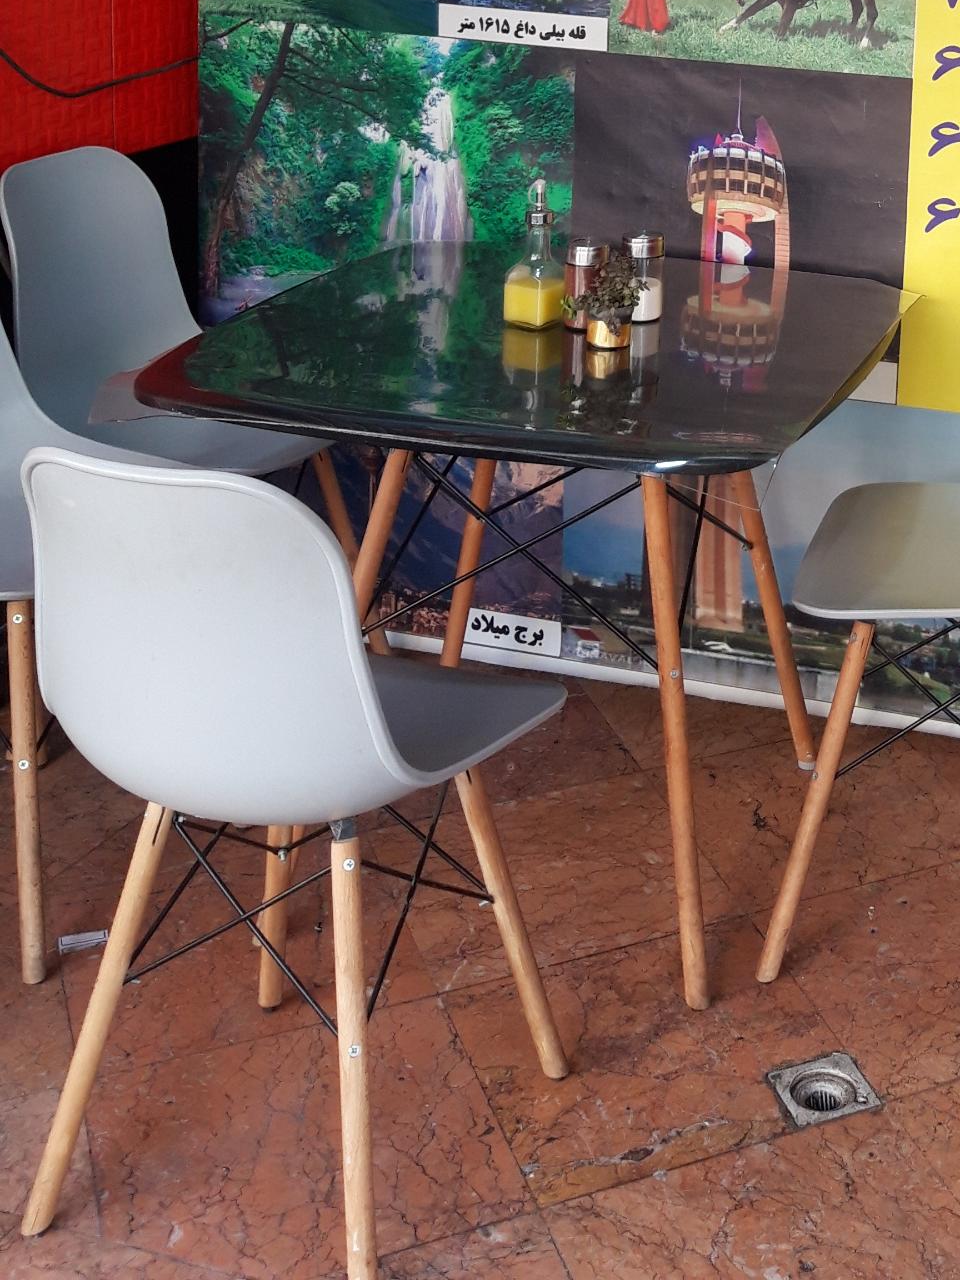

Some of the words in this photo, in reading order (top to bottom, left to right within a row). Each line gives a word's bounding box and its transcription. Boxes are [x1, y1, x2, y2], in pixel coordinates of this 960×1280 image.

[457, 18, 475, 33] متر
[479, 17, 510, 34] ۱۶۱۵
[514, 20, 536, 38] داغ
[539, 24, 565, 42] بیلی
[569, 25, 586, 40] قله
[471, 614, 510, 639] میلاد
[514, 625, 544, 647] برج
